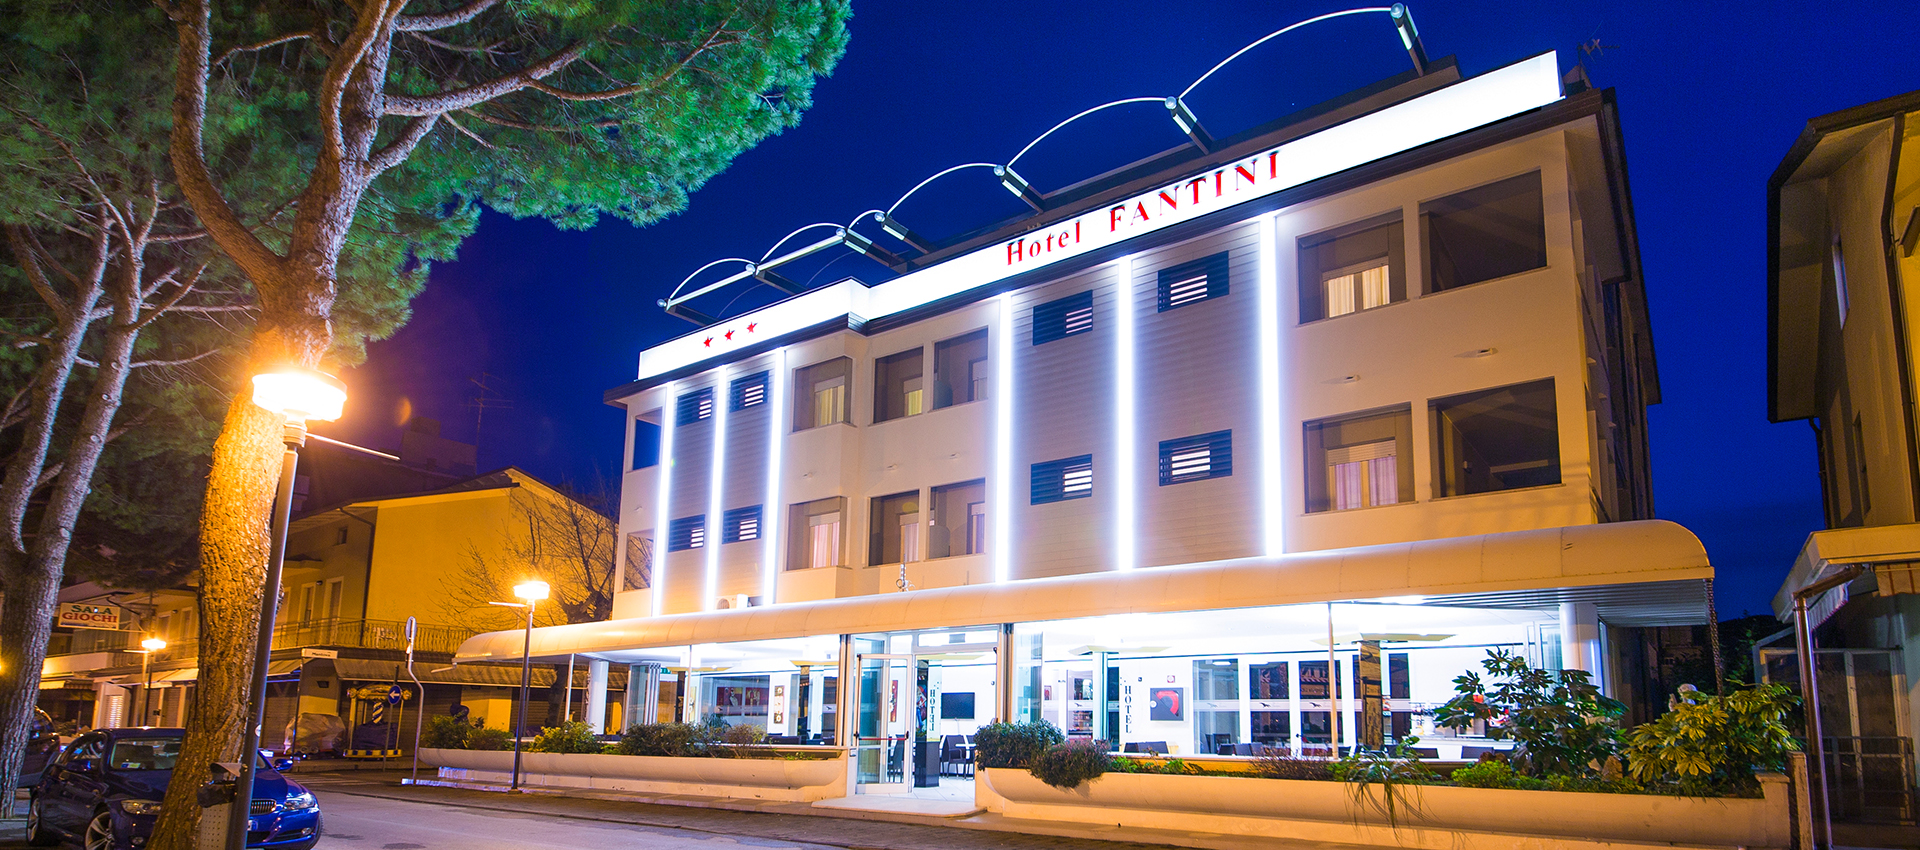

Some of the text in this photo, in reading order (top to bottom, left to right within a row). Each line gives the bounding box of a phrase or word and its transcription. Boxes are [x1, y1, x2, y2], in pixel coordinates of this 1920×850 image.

[1006, 151, 1279, 266] Hotel FANTINI
[62, 612, 117, 622] GIOCHI
[1124, 685, 1132, 734] HOTEL
